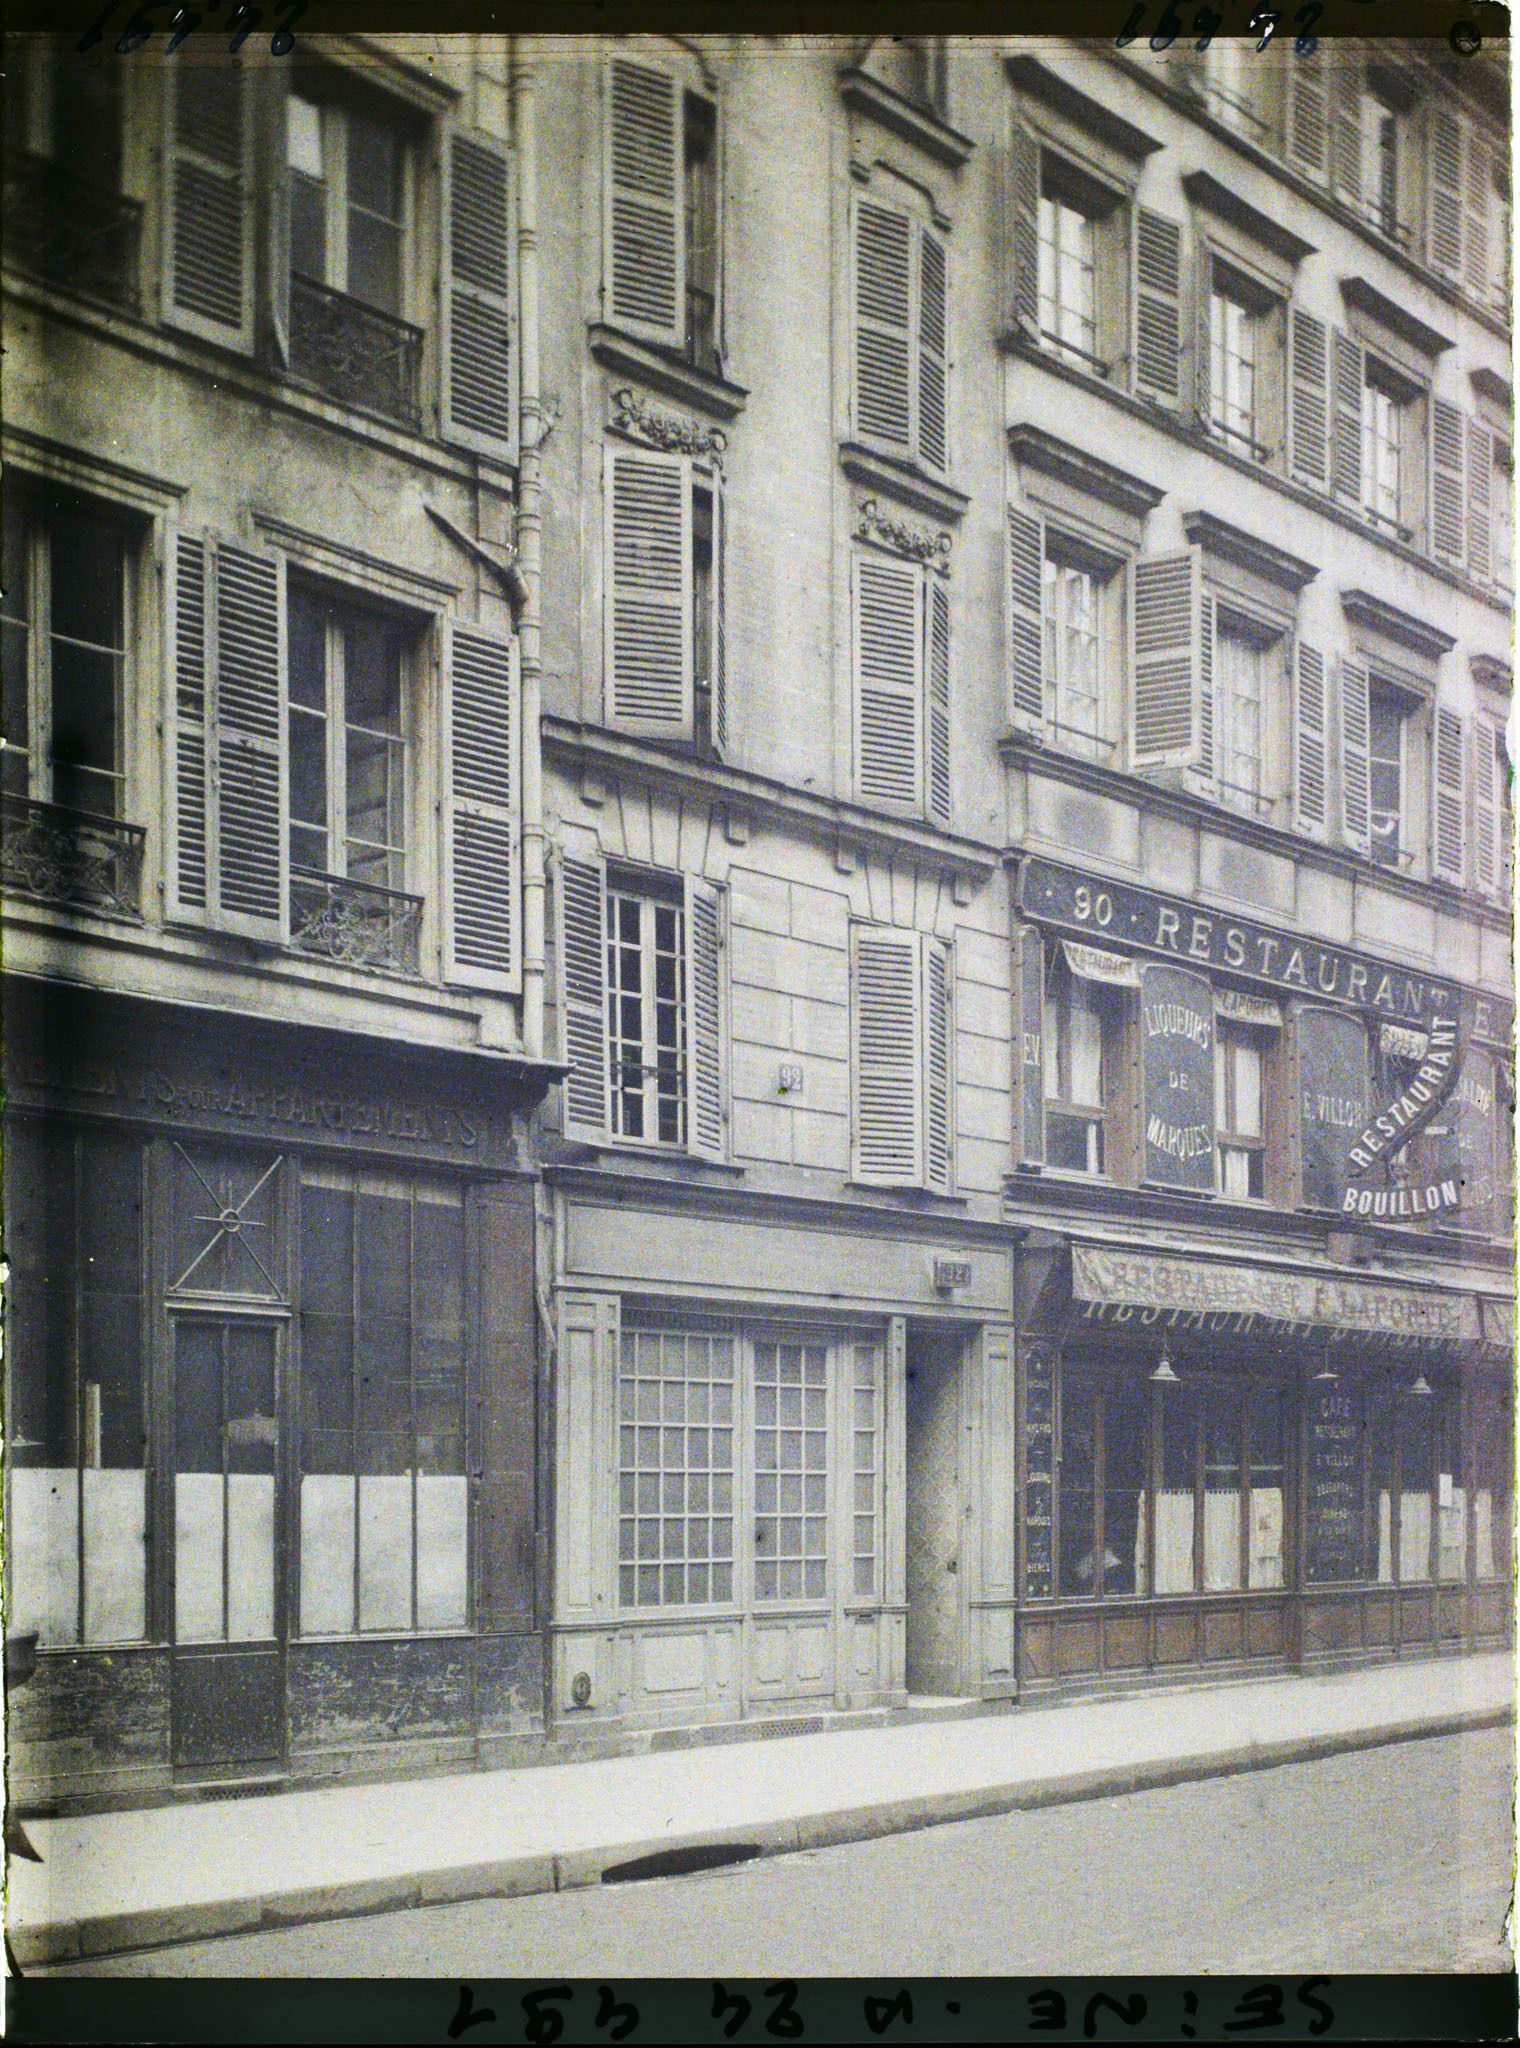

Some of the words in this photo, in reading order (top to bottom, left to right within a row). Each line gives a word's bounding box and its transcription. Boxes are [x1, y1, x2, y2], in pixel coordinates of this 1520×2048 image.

[1073, 886, 1113, 926] 90
[1155, 908, 1449, 1014] RESTAURANT
[1145, 1006, 1213, 1050] LIQUEURS
[1169, 1070, 1189, 1090] DE
[1348, 1016, 1457, 1169] RESTAURANT
[1147, 1113, 1213, 1158] MARQUES
[1342, 1180, 1459, 1217] BOUILLON
[447, 1984, 640, 2044] 491
[711, 1979, 804, 2039] 24
